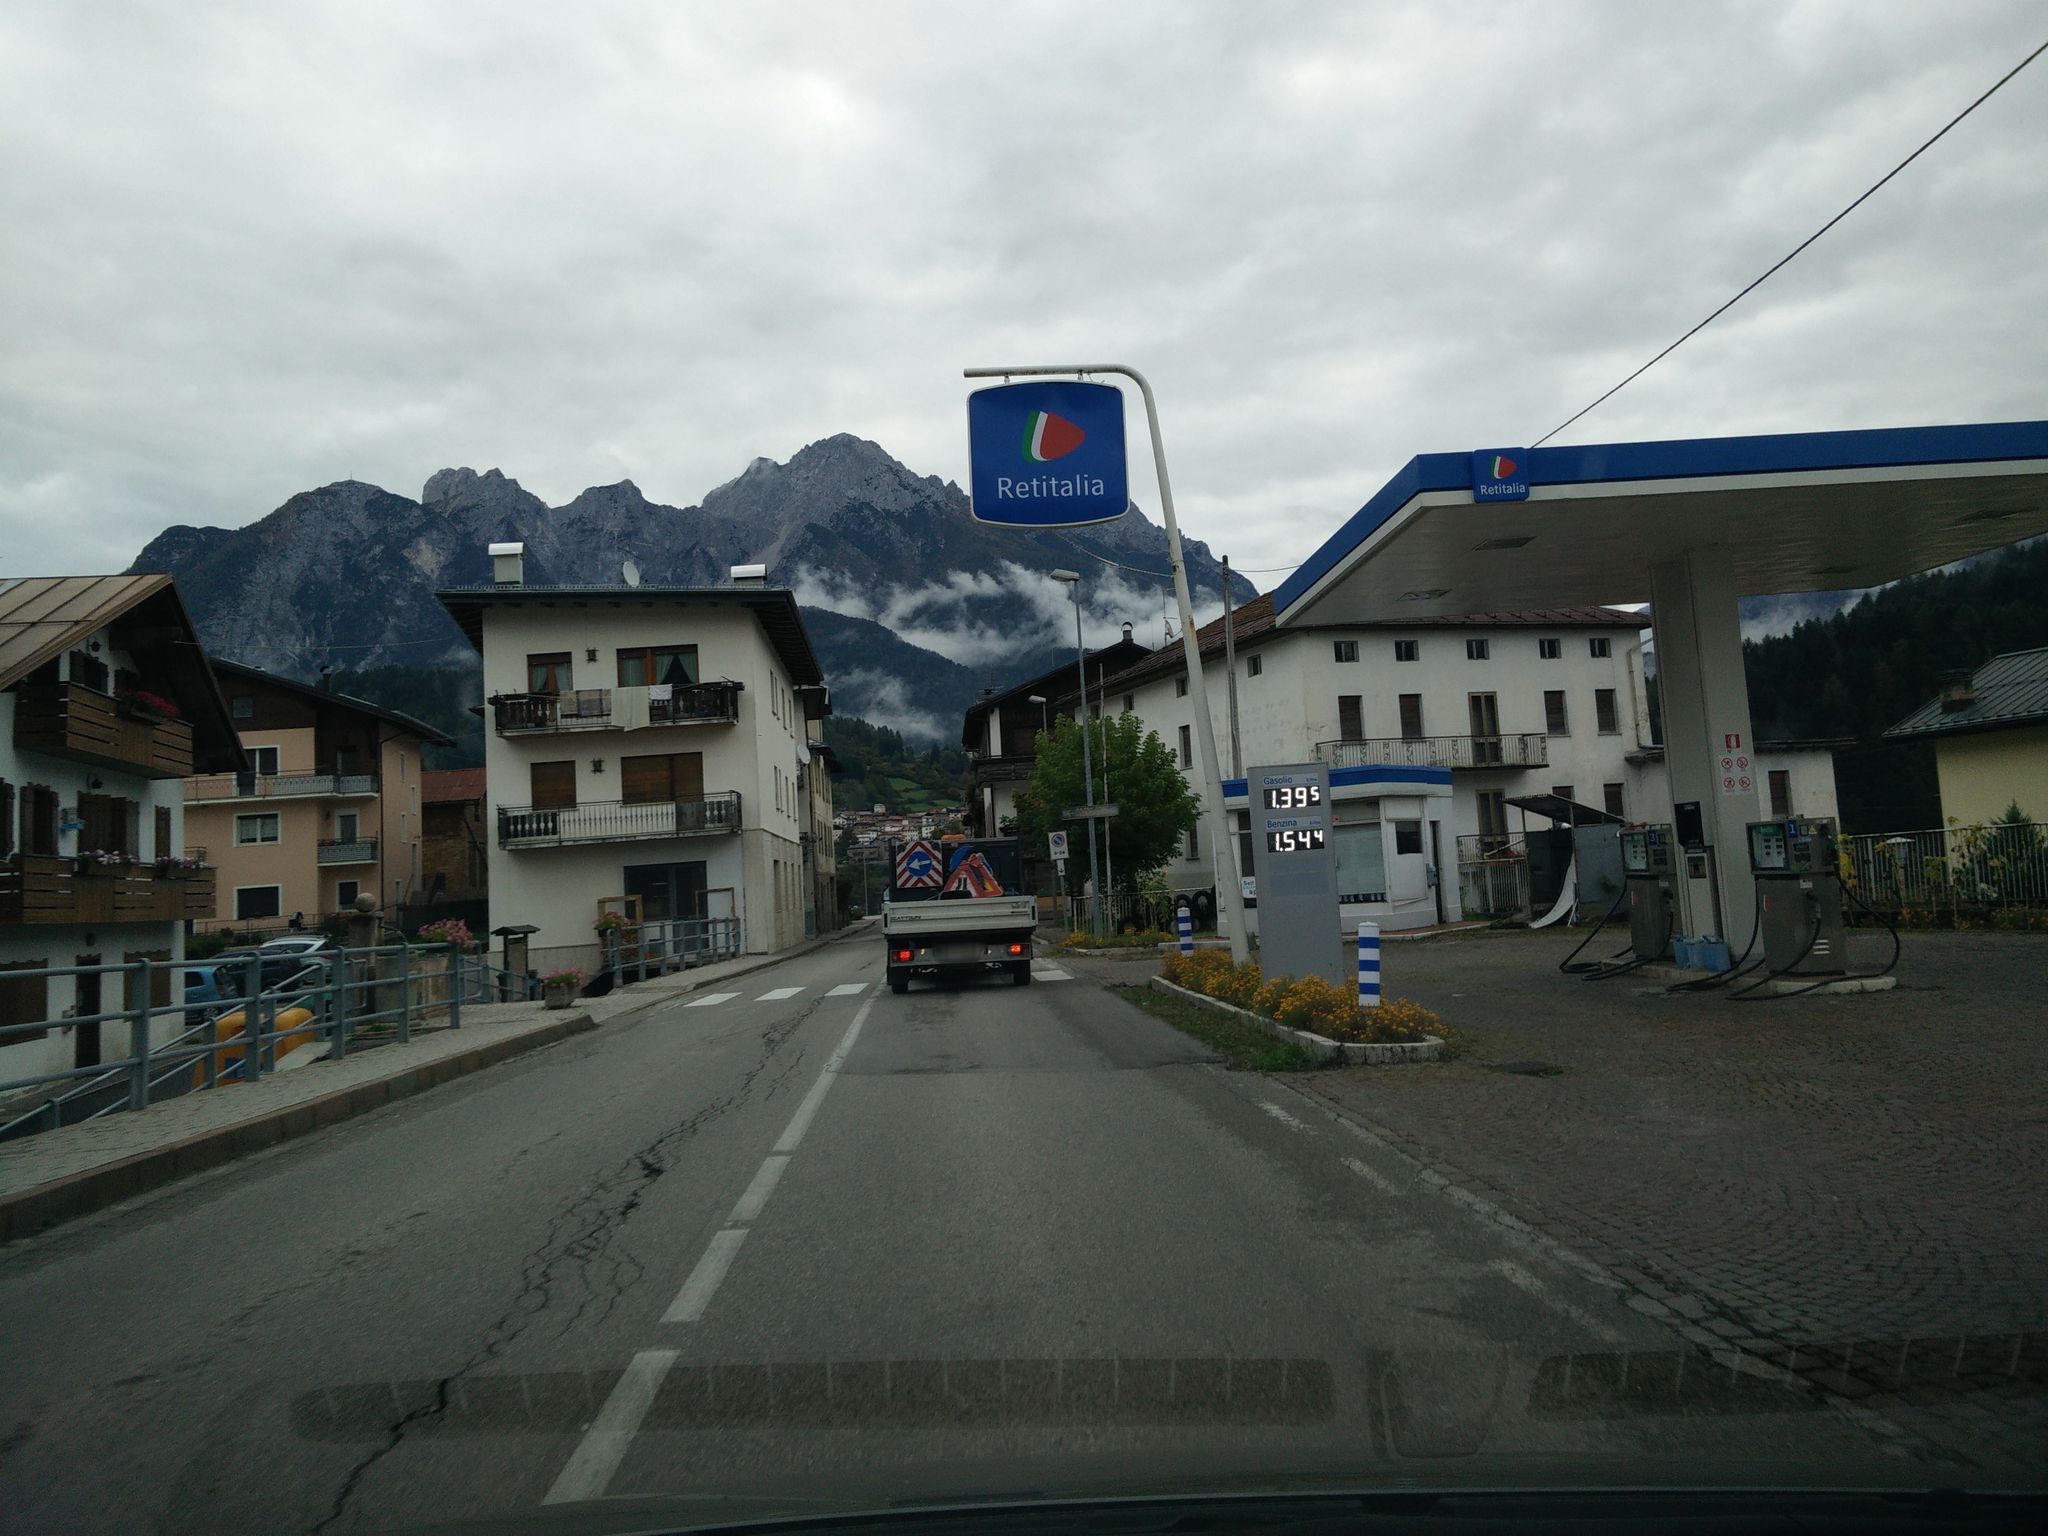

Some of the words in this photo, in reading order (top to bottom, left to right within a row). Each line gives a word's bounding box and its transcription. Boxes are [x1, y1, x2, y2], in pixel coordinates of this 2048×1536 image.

[997, 474, 1104, 499] Retitalia
[1480, 482, 1526, 495] Retitalia
[1263, 776, 1293, 785] Gasolio
[1266, 819, 1298, 829] Benzina
